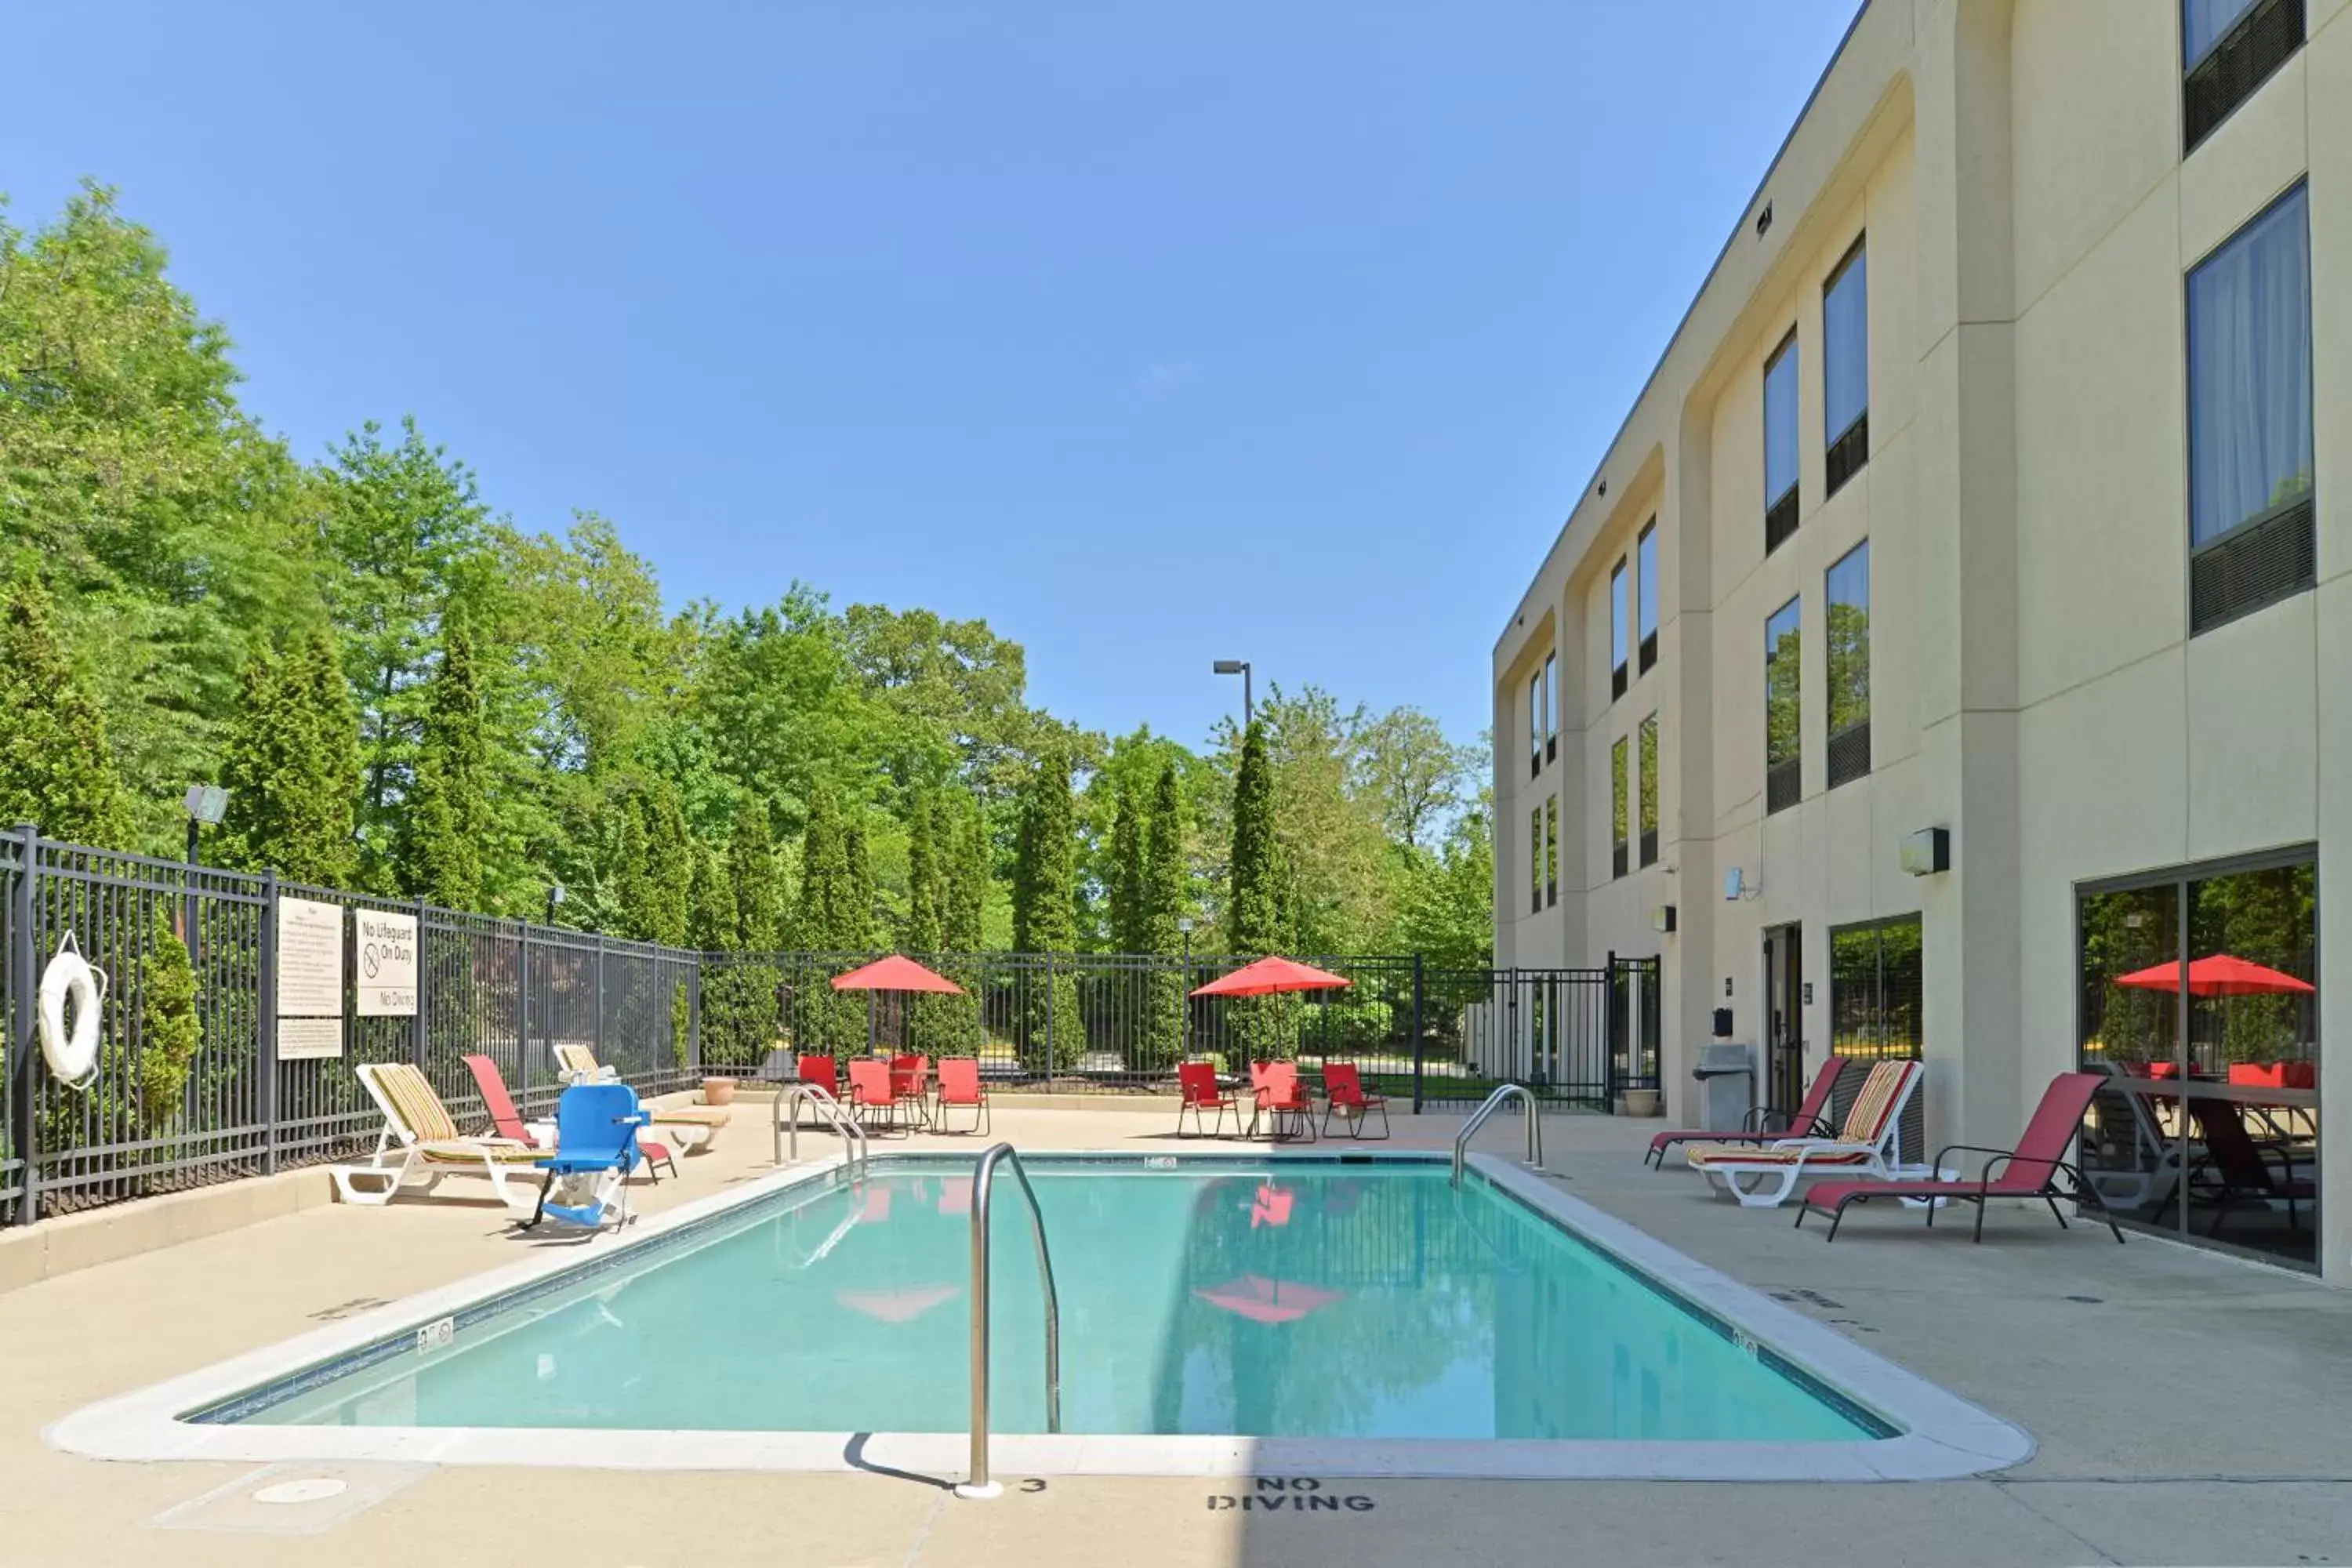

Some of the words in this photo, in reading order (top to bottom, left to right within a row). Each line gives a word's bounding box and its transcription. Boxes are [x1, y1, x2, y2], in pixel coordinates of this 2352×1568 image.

[363, 921, 375, 938] No
[377, 922, 412, 943] Lifeguard
[381, 944, 393, 960] On
[394, 946, 412, 965] Duty
[380, 990, 391, 1006] No
[392, 991, 414, 1011] Diving
[1020, 1478, 1047, 1493] 3
[1257, 1477, 1320, 1491] NO
[1207, 1495, 1375, 1512] DIVING
